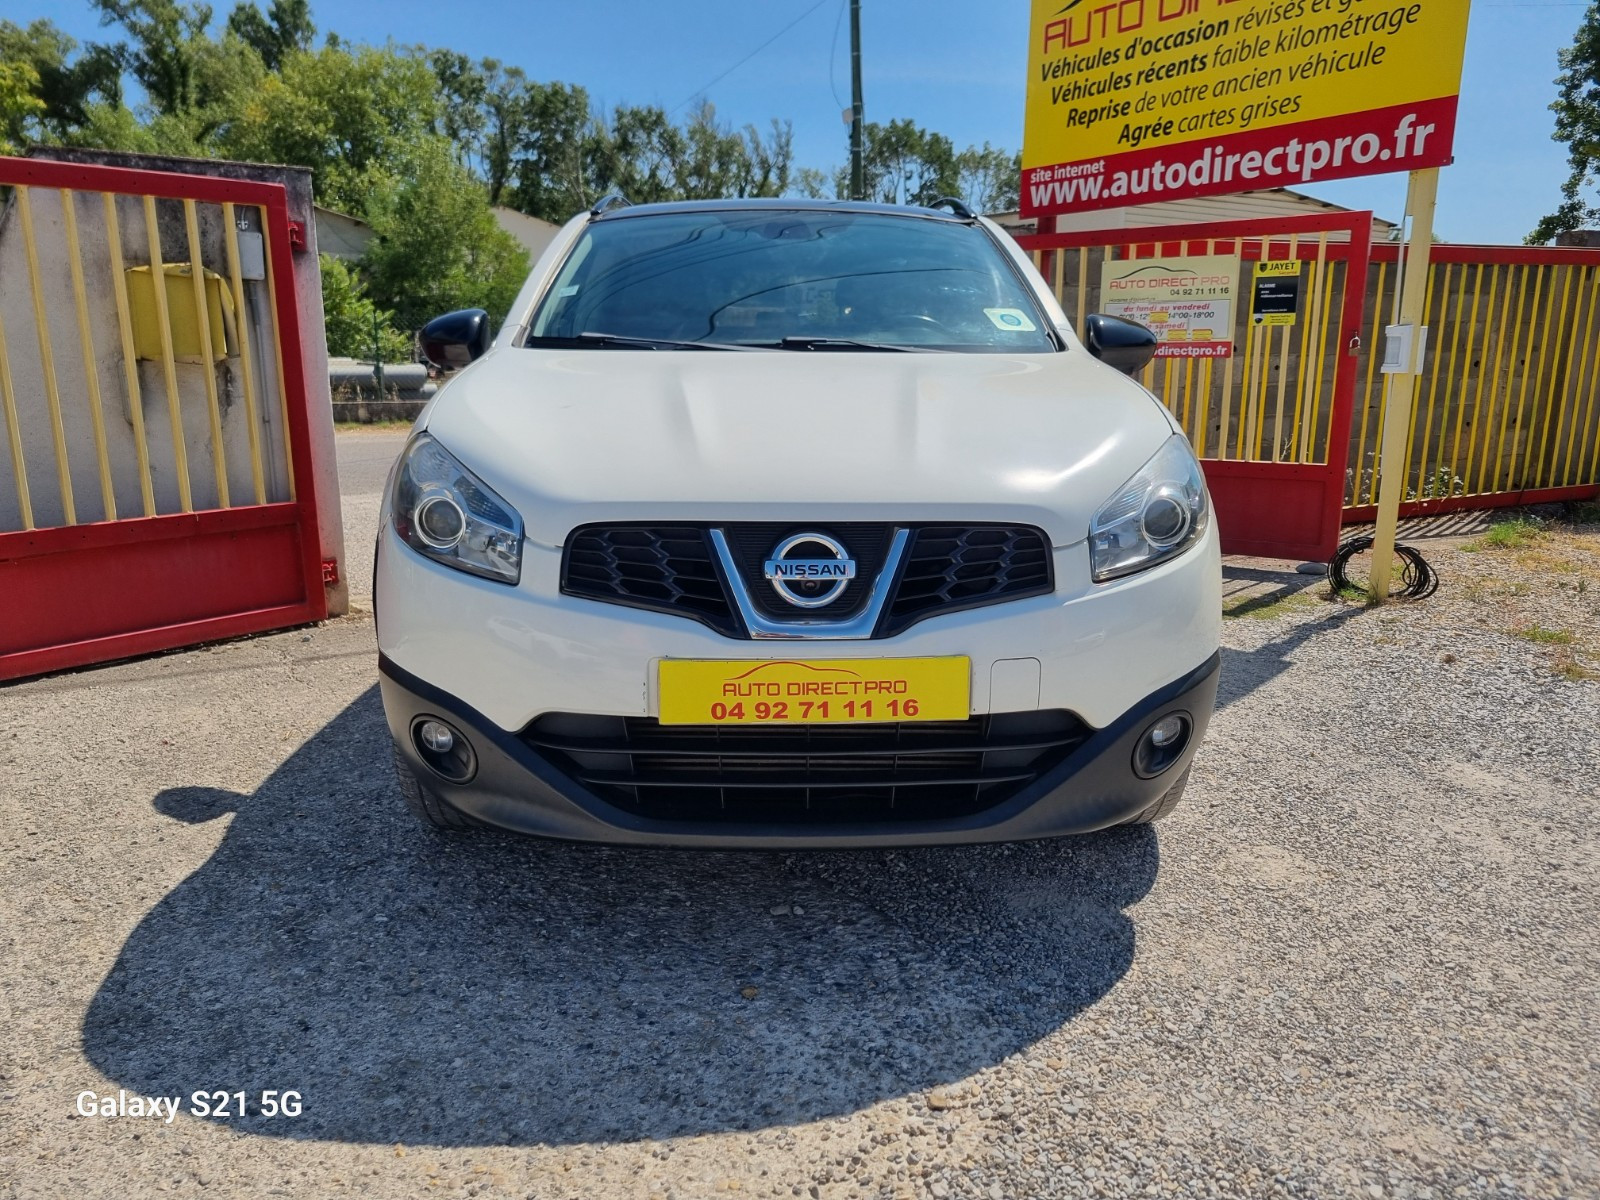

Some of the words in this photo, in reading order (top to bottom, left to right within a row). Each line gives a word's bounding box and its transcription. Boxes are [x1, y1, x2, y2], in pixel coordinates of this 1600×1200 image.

[1044, 0, 1144, 54] AUTO
[1041, 48, 1120, 81] Véhicules
[1125, 19, 1229, 60] d'occasion
[1052, 71, 1131, 104] Véhicules
[1136, 52, 1208, 86] récents
[1212, 35, 1271, 68] faible
[1275, 4, 1421, 54] kilométrage
[1067, 99, 1131, 128] Reprise
[1135, 91, 1156, 114] de
[1161, 83, 1208, 109] votre
[1212, 68, 1281, 98] ancien
[1289, 41, 1386, 82] véhicule
[1118, 116, 1174, 147] Agrée
[1178, 107, 1236, 134] cartes
[1240, 95, 1302, 128] grises
[1030, 113, 1435, 208] www.autodirectpro.fr
[1030, 167, 1052, 184] site
[1054, 159, 1105, 180] internet
[1269, 262, 1296, 271] JAYET
[1109, 279, 1146, 290] AUTO
[1149, 277, 1198, 288] DIRECT
[1200, 275, 1231, 286] PRO
[1207, 287, 1217, 295] 11
[1219, 286, 1230, 294] 16
[1136, 304, 1157, 312] lundi
[1172, 303, 1210, 311] vendredi
[775, 564, 846, 576] NISSAN
[722, 682, 781, 697] AUTO
[710, 701, 745, 721] 04
[754, 701, 789, 720] 92
[799, 700, 829, 719] 71
[843, 700, 873, 718] 11
[886, 698, 920, 717] 16
